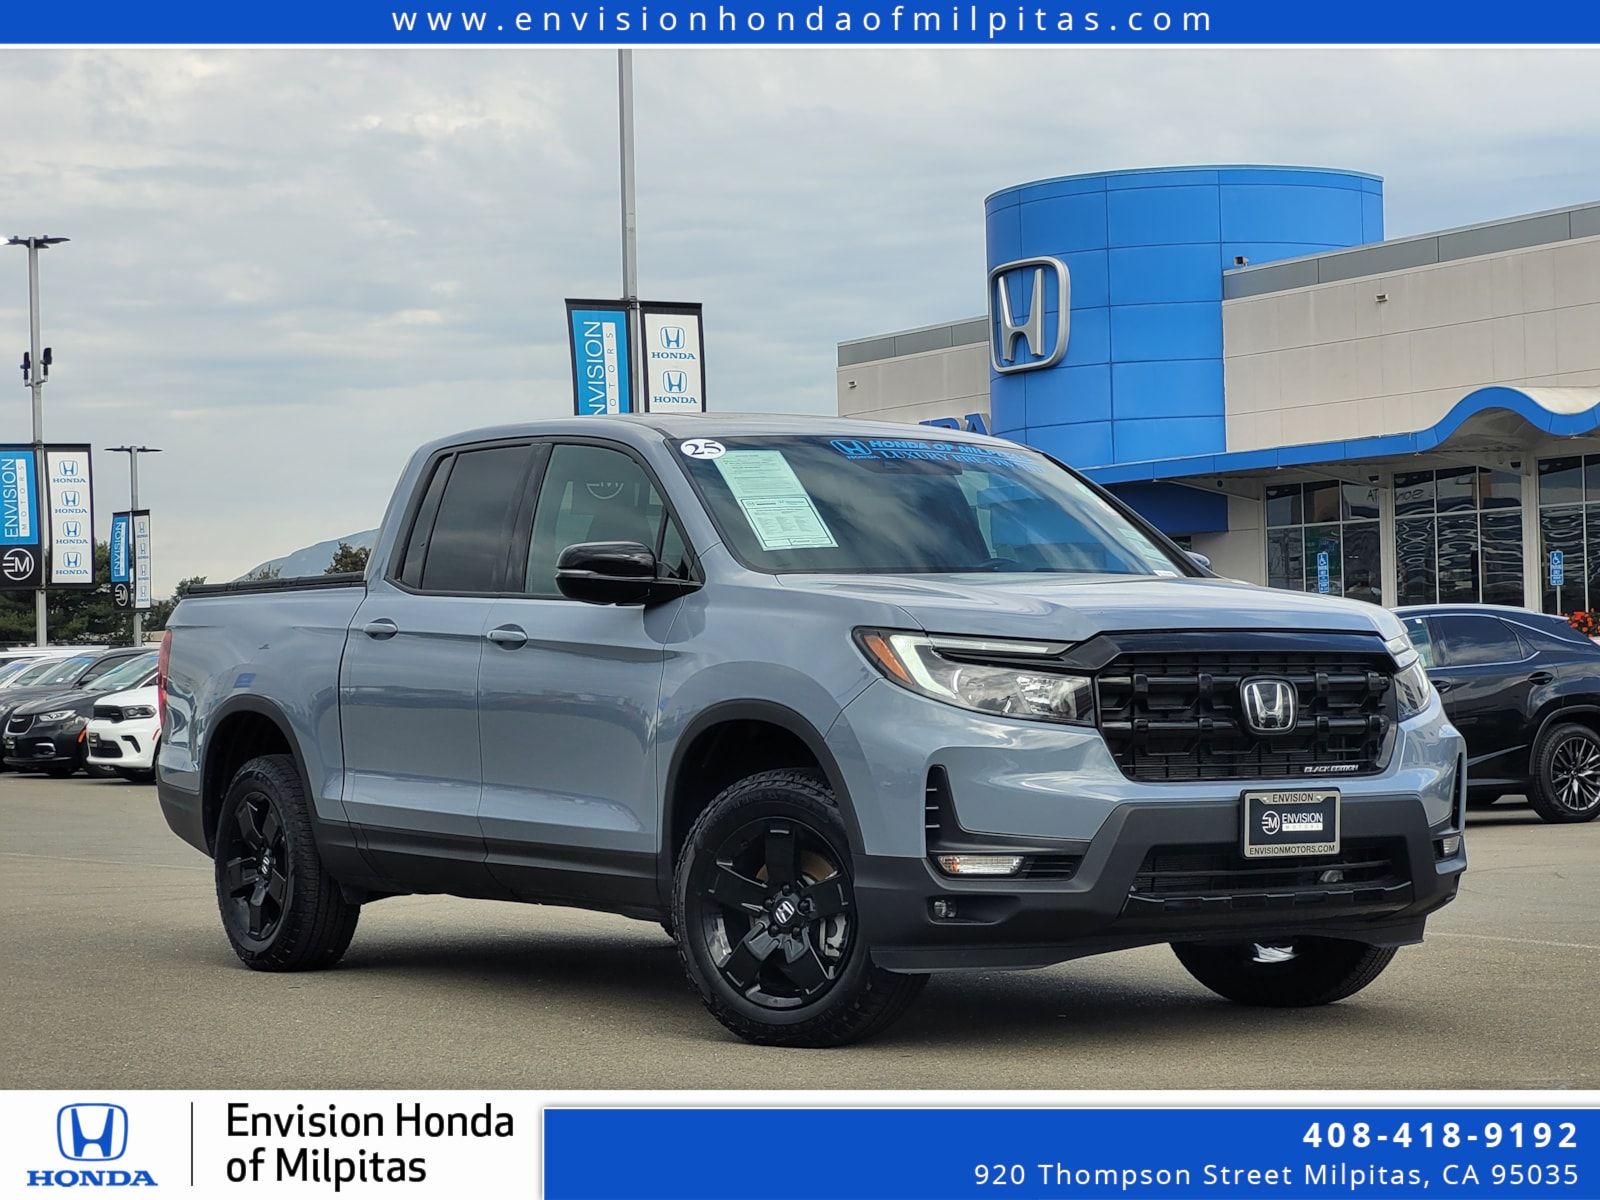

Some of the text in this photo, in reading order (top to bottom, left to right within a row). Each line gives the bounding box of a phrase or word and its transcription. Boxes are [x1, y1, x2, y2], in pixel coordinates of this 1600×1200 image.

[651, 351, 696, 360] HONDA
[606, 332, 616, 407] OTORS
[653, 396, 698, 404] HONDA
[685, 442, 721, 455] 25
[868, 440, 1033, 462] HONDA OF MILPI
[880, 450, 1045, 473] LUXURY PRE-OW
[2, 458, 18, 538] ENVISION
[18, 465, 27, 531] MOTORS
[113, 522, 122, 577] ENVISION
[1272, 793, 1314, 803] ENVISION
[1282, 813, 1323, 823] ENVISION
[1249, 845, 1336, 856] ENVISIONMOTORS.COM
